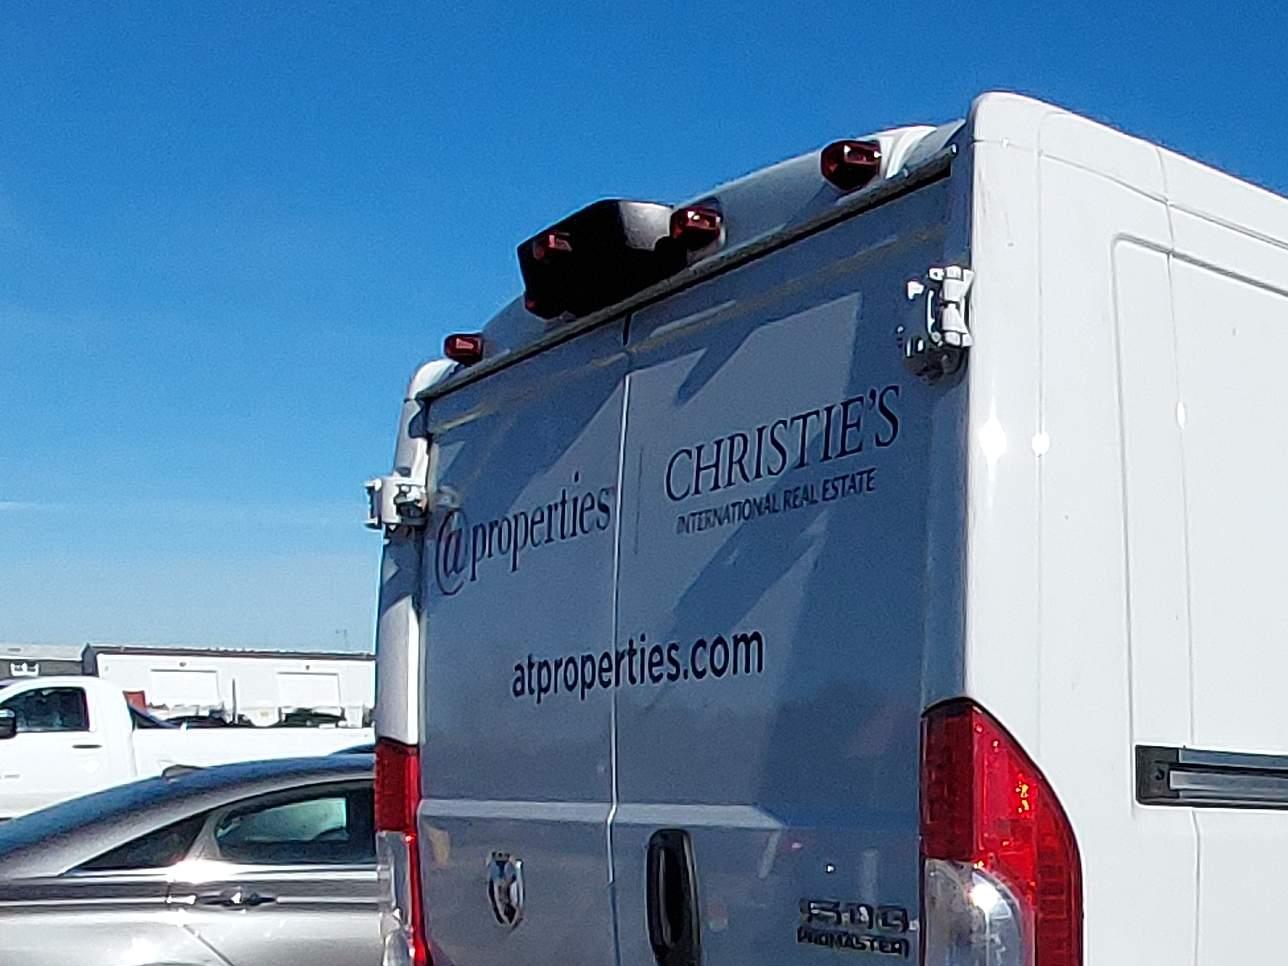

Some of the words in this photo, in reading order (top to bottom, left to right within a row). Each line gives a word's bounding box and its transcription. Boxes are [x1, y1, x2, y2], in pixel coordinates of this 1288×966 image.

[664, 384, 900, 502] CHRISTIE'S
[676, 497, 780, 534] INTERNATIONAL
[783, 484, 819, 511] REAL
[821, 467, 877, 502] ESTATE
[511, 630, 764, 704] atproperties.com
